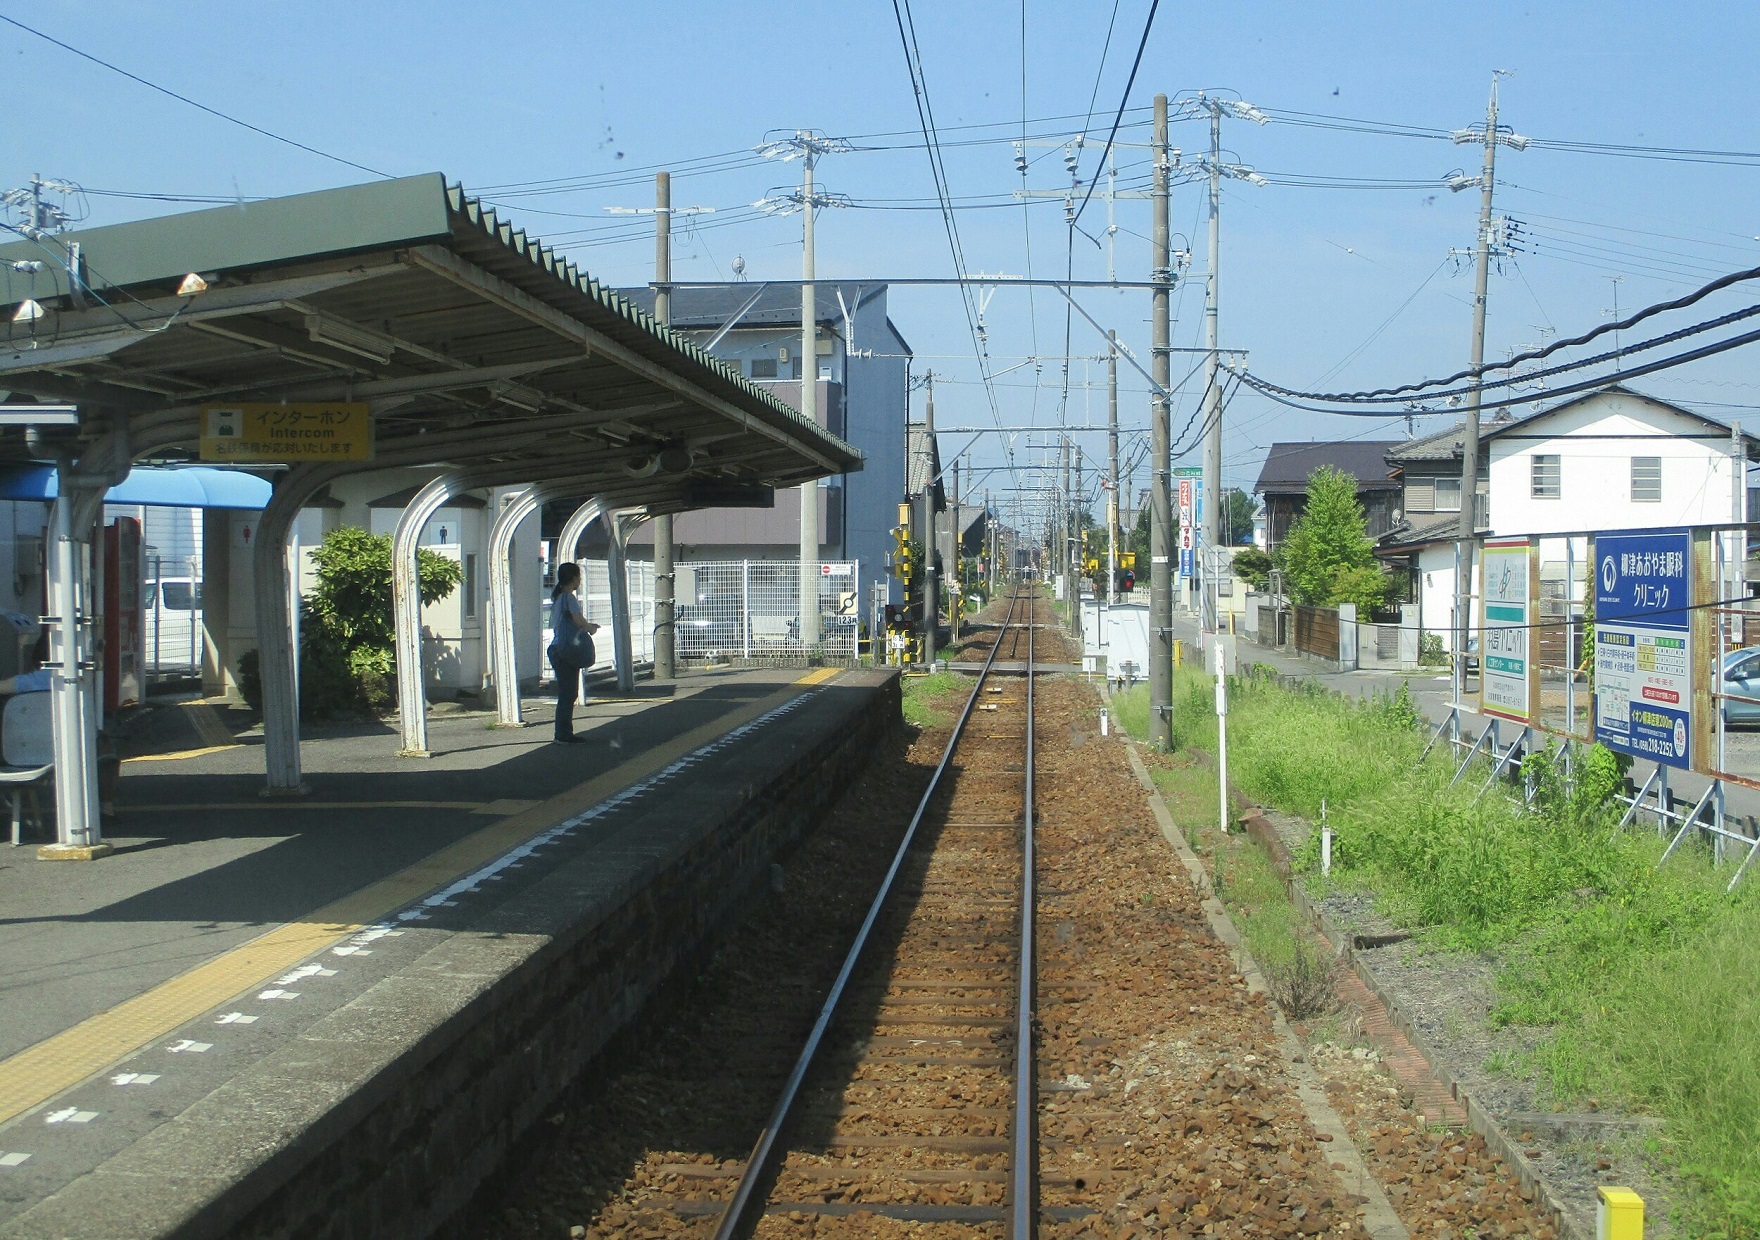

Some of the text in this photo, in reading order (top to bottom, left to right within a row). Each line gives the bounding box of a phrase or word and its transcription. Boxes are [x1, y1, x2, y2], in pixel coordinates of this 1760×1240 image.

[257, 410, 351, 425] インターホン
[271, 427, 334, 438] Intercom
[1621, 551, 1684, 578] 柳津あおやま眼科
[1634, 584, 1669, 608] クリニック
